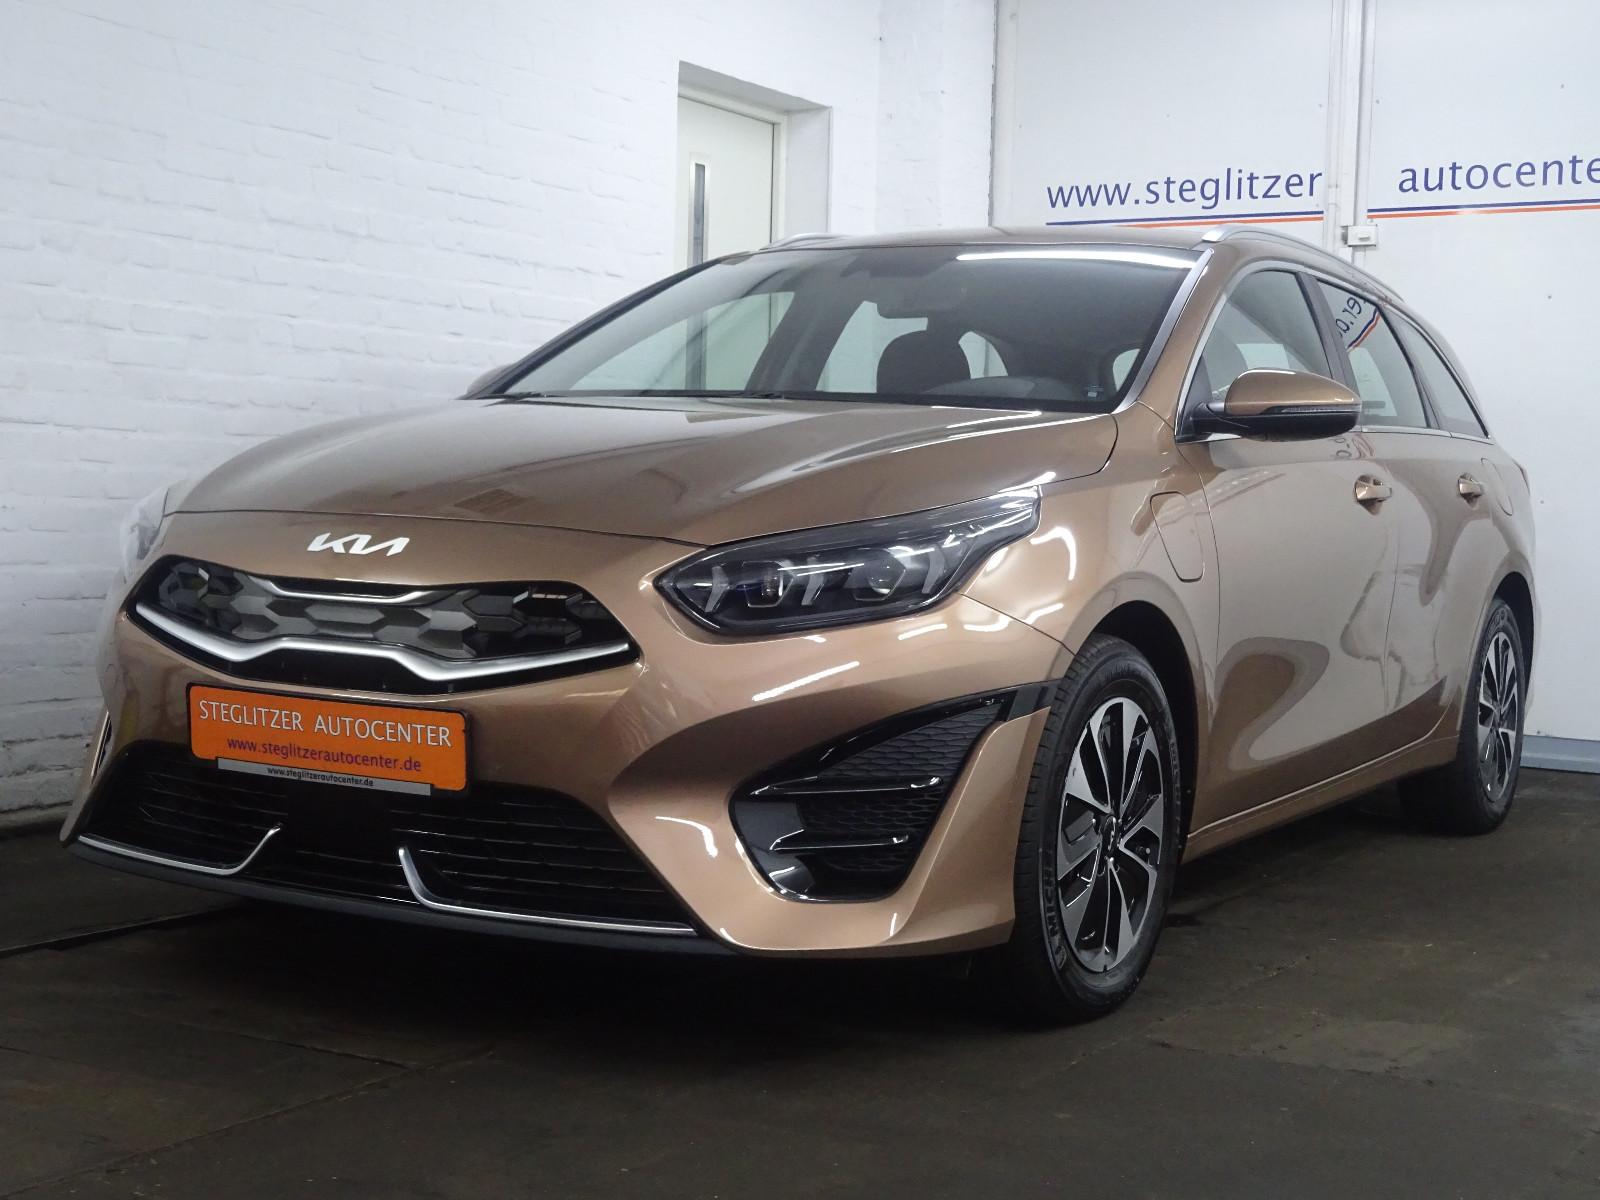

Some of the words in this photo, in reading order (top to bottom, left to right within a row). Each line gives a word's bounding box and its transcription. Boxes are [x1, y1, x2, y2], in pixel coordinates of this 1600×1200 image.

[1047, 168, 1322, 209] www.steglitzer
[307, 532, 410, 556] KIA
[199, 700, 304, 731] STEGLITZER
[314, 714, 451, 747] AUTOCENTER
[227, 737, 422, 772] www.steglitzerautocenter.de
